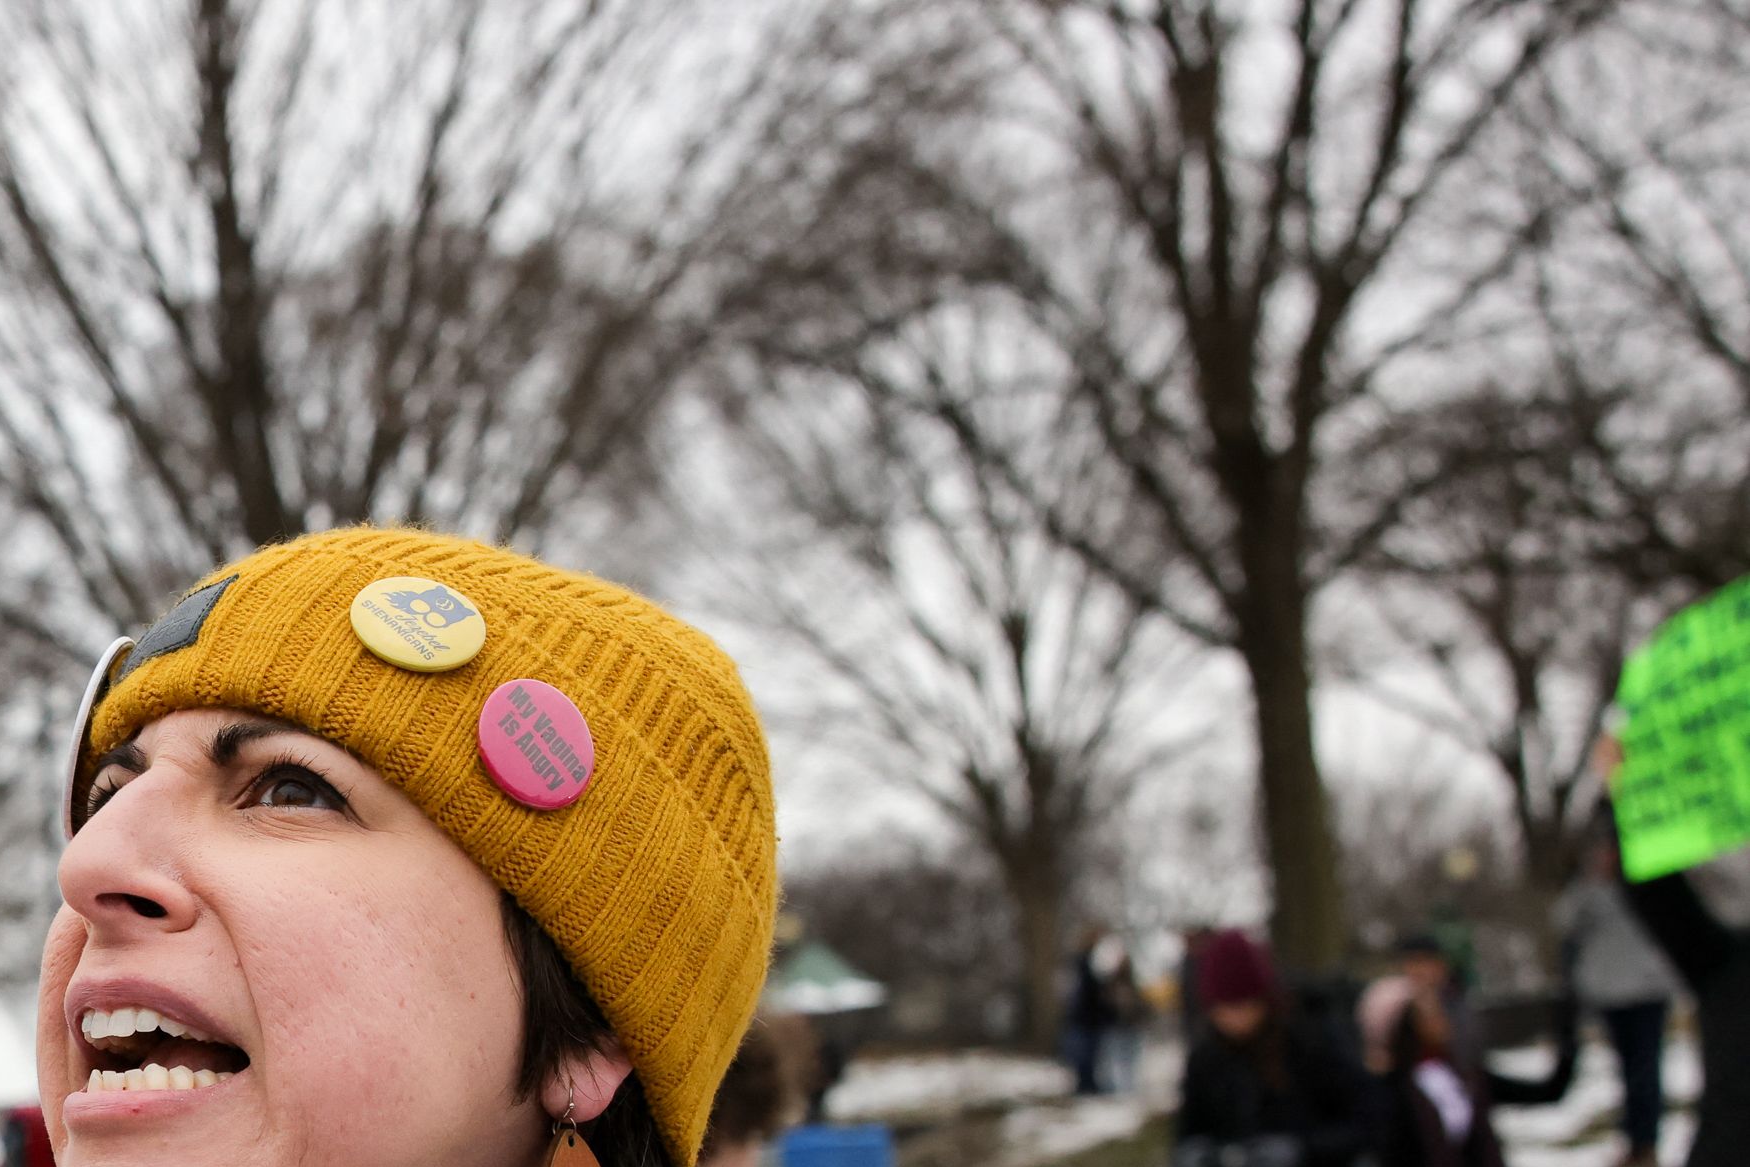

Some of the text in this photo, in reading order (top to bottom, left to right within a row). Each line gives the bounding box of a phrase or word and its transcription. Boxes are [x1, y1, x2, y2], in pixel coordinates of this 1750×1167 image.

[361, 600, 435, 661] SHENANIGANS
[394, 614, 451, 651] Jezebel
[507, 685, 587, 784] My Vagina
[514, 731, 565, 791] Angry
